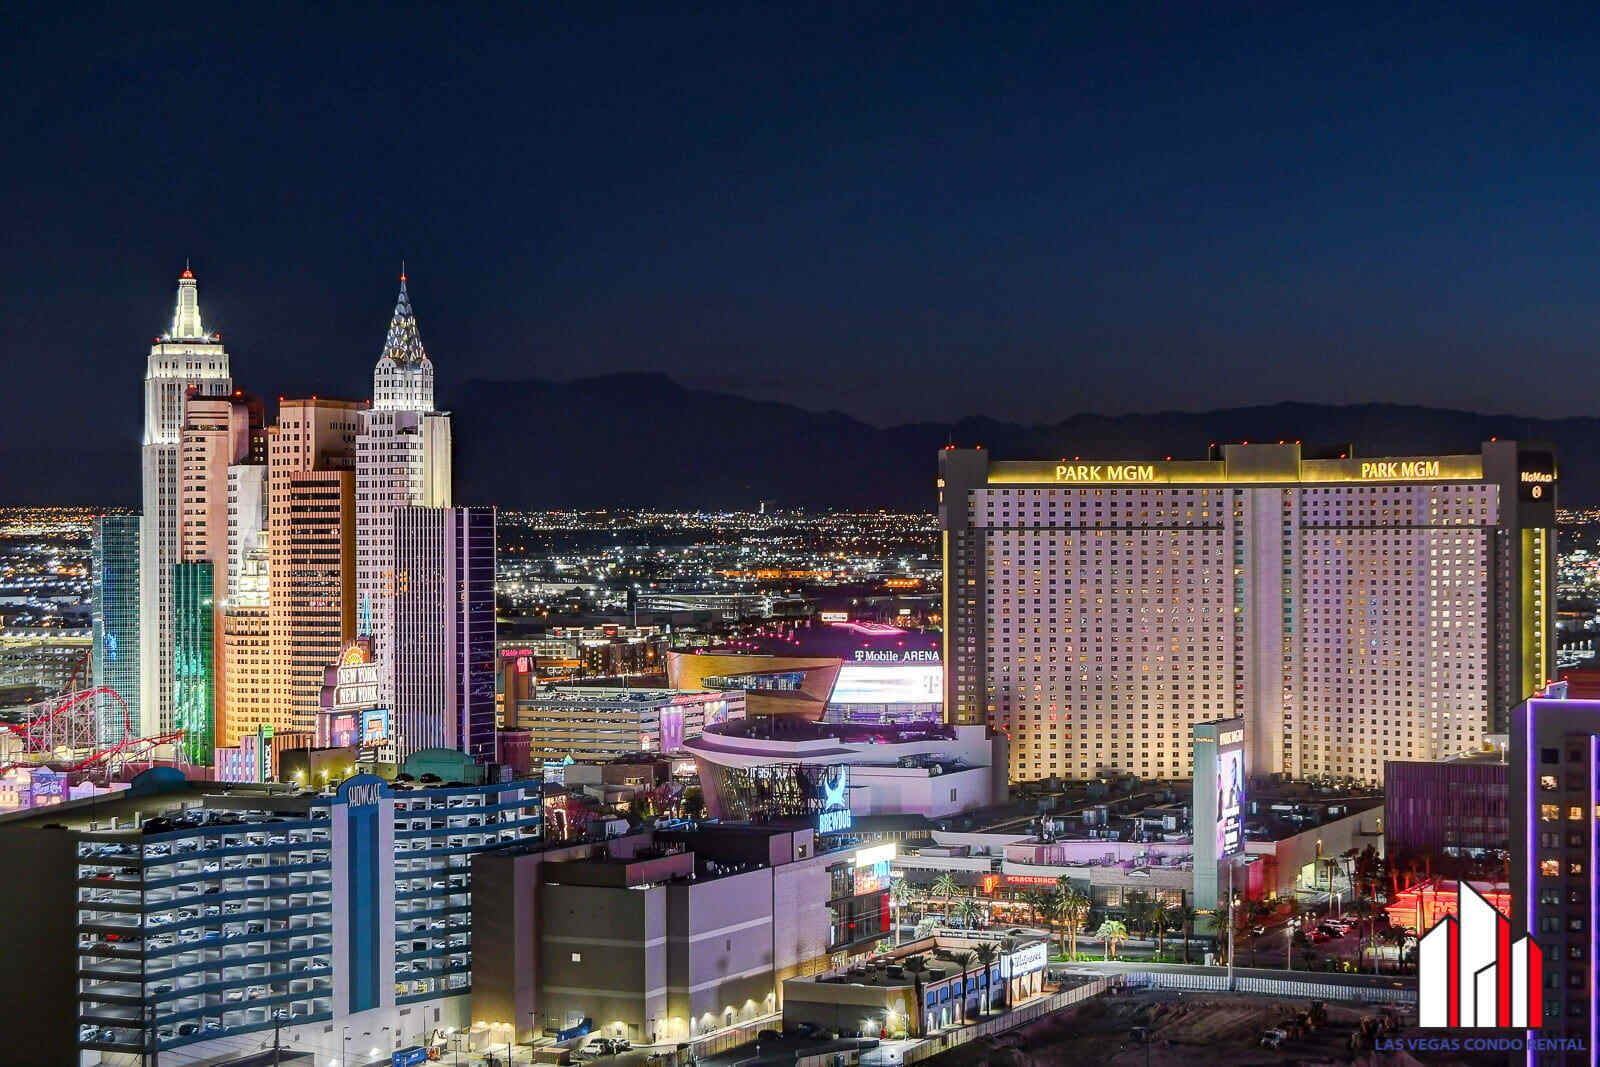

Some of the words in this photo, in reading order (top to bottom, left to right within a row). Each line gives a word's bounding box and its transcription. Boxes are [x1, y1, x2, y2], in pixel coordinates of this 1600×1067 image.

[1056, 465, 1102, 481] PARK
[1107, 465, 1154, 481] MGM
[1361, 462, 1398, 478] PARK
[1401, 461, 1440, 477] MGM
[903, 650, 940, 661] ARENA
[340, 668, 357, 685] NEW
[358, 666, 378, 683] YORK
[339, 686, 357, 704] NEW
[348, 783, 381, 808] SHOWCASE
[819, 809, 852, 834] BREWDOG
